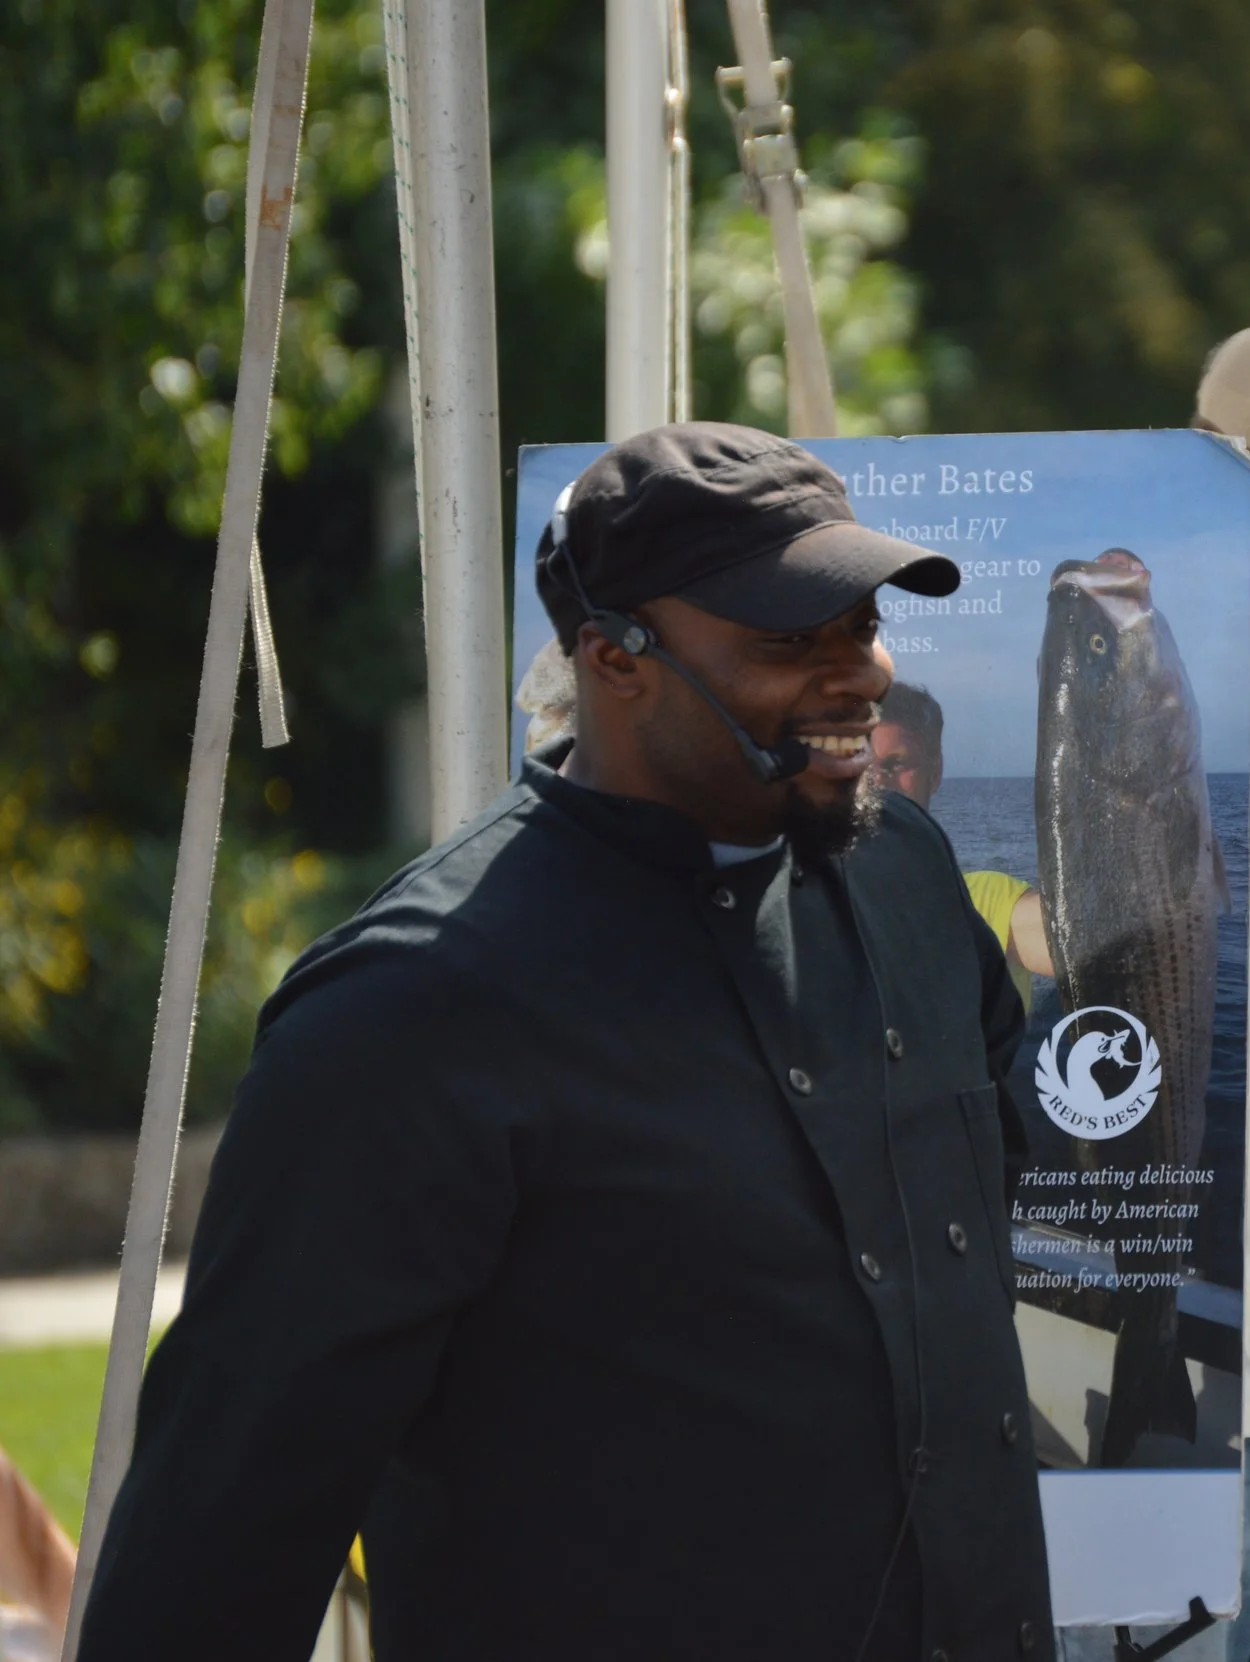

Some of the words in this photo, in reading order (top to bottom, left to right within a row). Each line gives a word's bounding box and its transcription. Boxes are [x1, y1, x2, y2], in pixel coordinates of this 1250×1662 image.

[841, 462, 926, 497] ther
[938, 464, 1034, 495] Bates
[965, 517, 1008, 542] F/V
[960, 560, 1011, 584] gear
[1018, 559, 1041, 576] to
[958, 590, 1003, 615] and
[883, 629, 939, 653] bass.
[1049, 1095, 1098, 1130] RED'S
[1103, 1094, 1147, 1129] BEST
[1081, 1165, 1136, 1190] eating
[1139, 1164, 1215, 1185] delicious
[1027, 1199, 1087, 1225] caught
[1090, 1199, 1112, 1225] by
[1114, 1199, 1200, 1219] American
[1086, 1234, 1099, 1253] is
[1104, 1239, 1115, 1253] a
[1119, 1233, 1193, 1255] win/win
[1073, 1267, 1101, 1294] for
